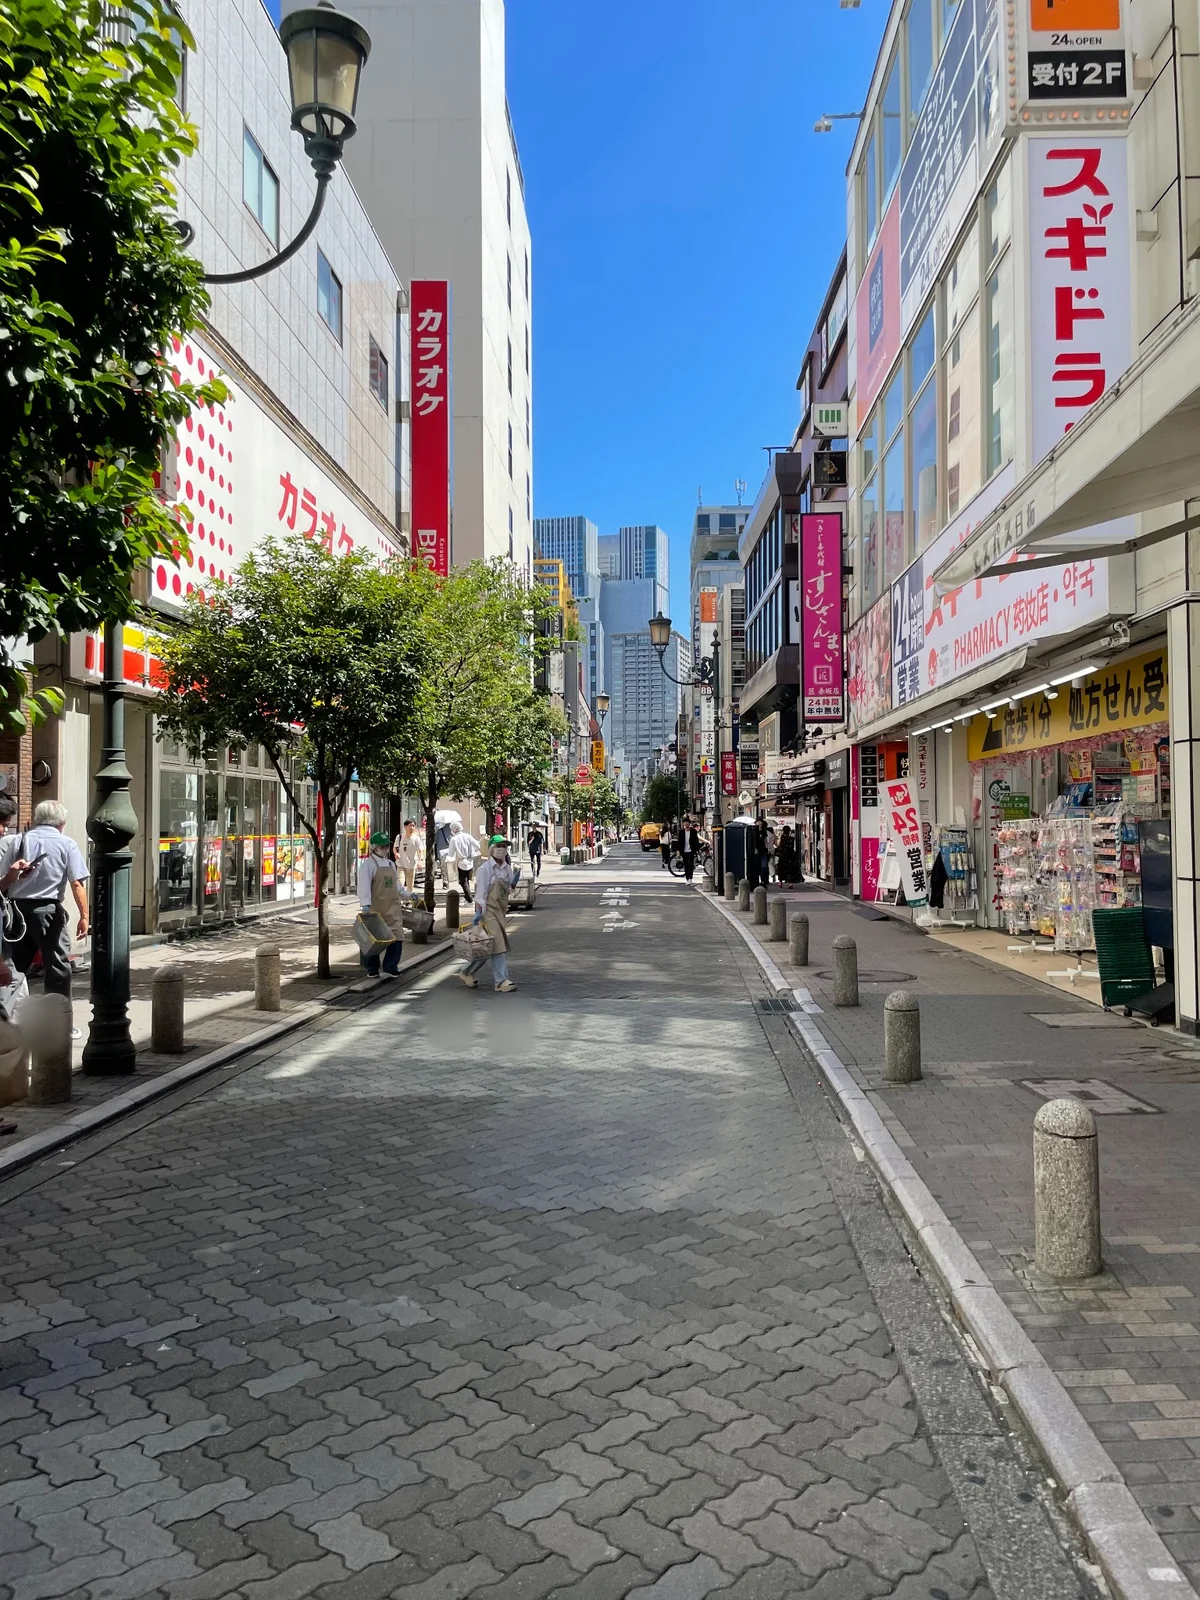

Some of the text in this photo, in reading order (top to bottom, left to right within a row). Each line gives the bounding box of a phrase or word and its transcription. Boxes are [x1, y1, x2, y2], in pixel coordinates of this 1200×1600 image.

[1075, 37, 1102, 45] OPEN
[1043, 148, 1114, 434] スギドラ
[415, 308, 444, 416] カラオケ
[278, 471, 354, 557] カラオケ
[805, 570, 840, 662] すしざんまい
[893, 574, 911, 665] 24
[954, 605, 1011, 671] PHARMACY
[807, 707, 840, 715] 年中無休
[808, 698, 839, 707] 24時間
[897, 655, 920, 706] 営業
[1004, 656, 1168, 746] 徒歩1分 処方せん受
[900, 757, 910, 769] 快
[918, 745, 928, 789] スギドラッグ
